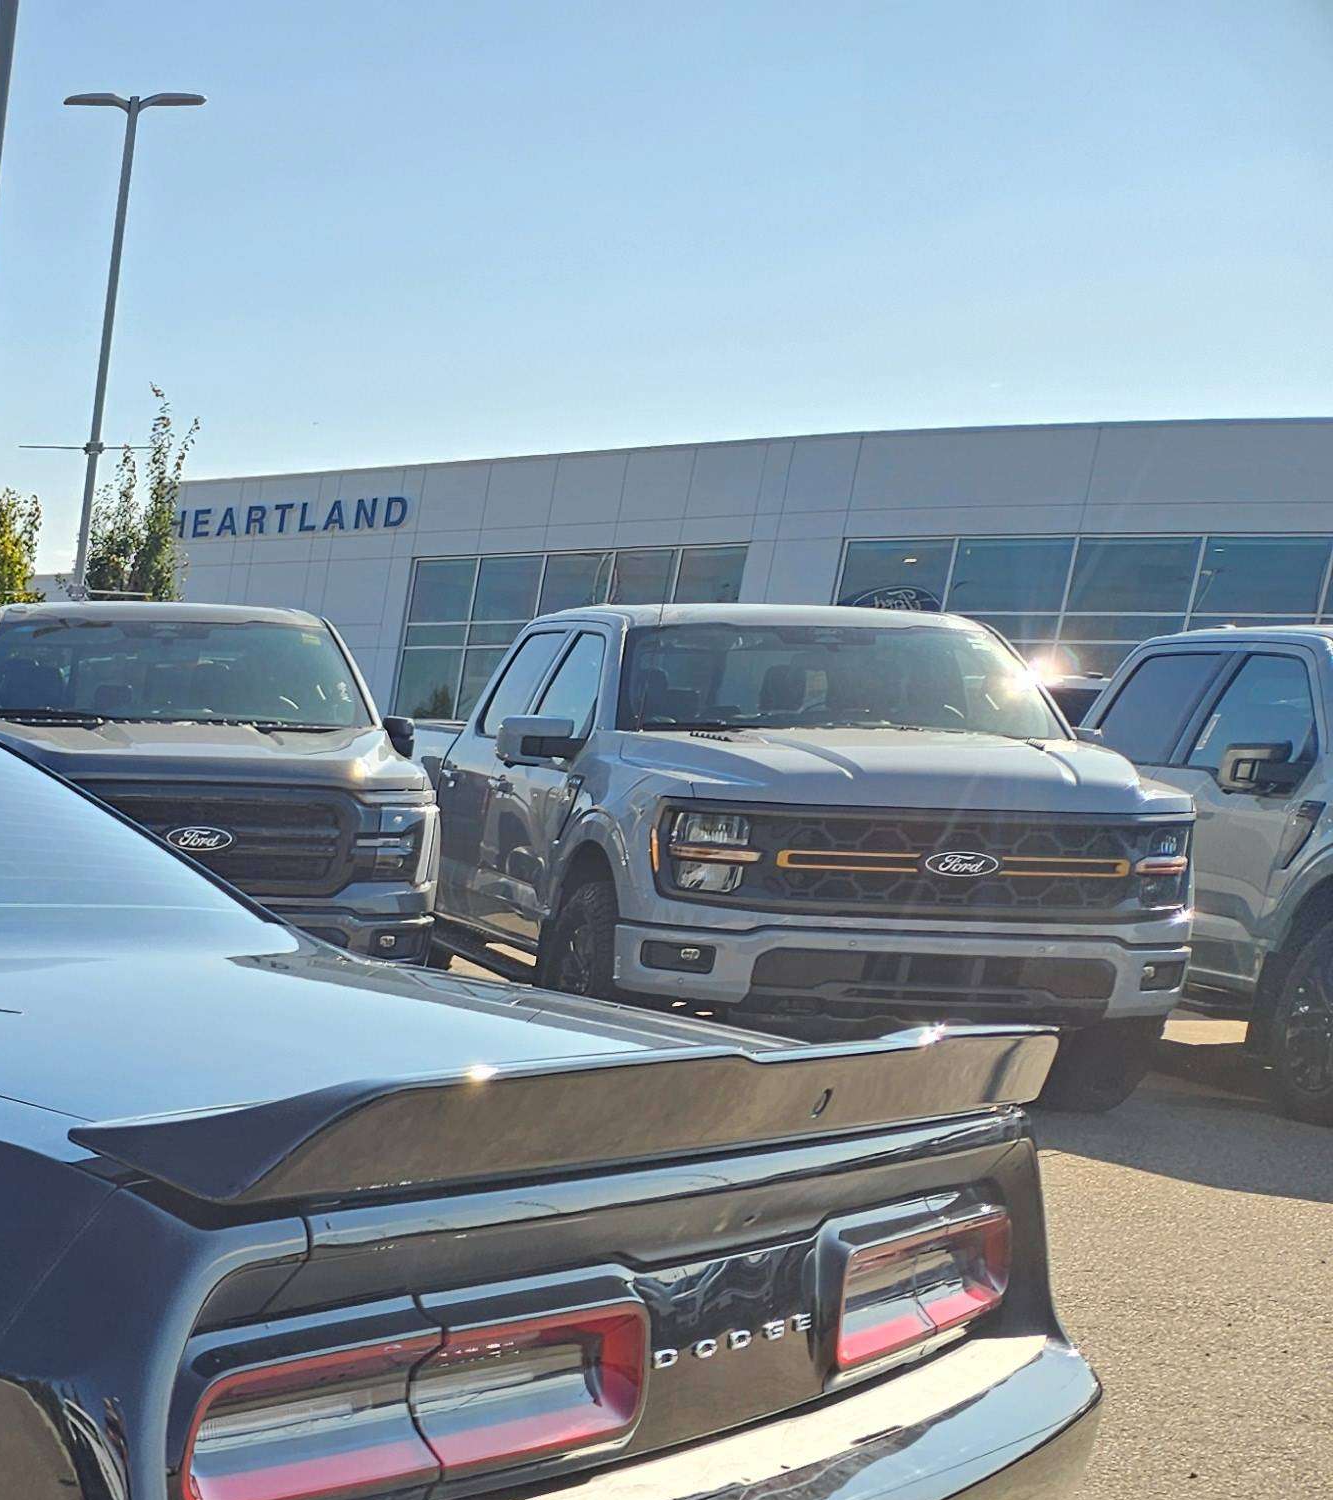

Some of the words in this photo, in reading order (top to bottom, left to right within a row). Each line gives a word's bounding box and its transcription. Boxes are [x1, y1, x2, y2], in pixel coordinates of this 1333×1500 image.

[171, 496, 409, 538] HEARTLAND
[176, 828, 222, 848] Ford
[936, 853, 988, 874] Ford
[651, 1312, 813, 1370] DODGE
